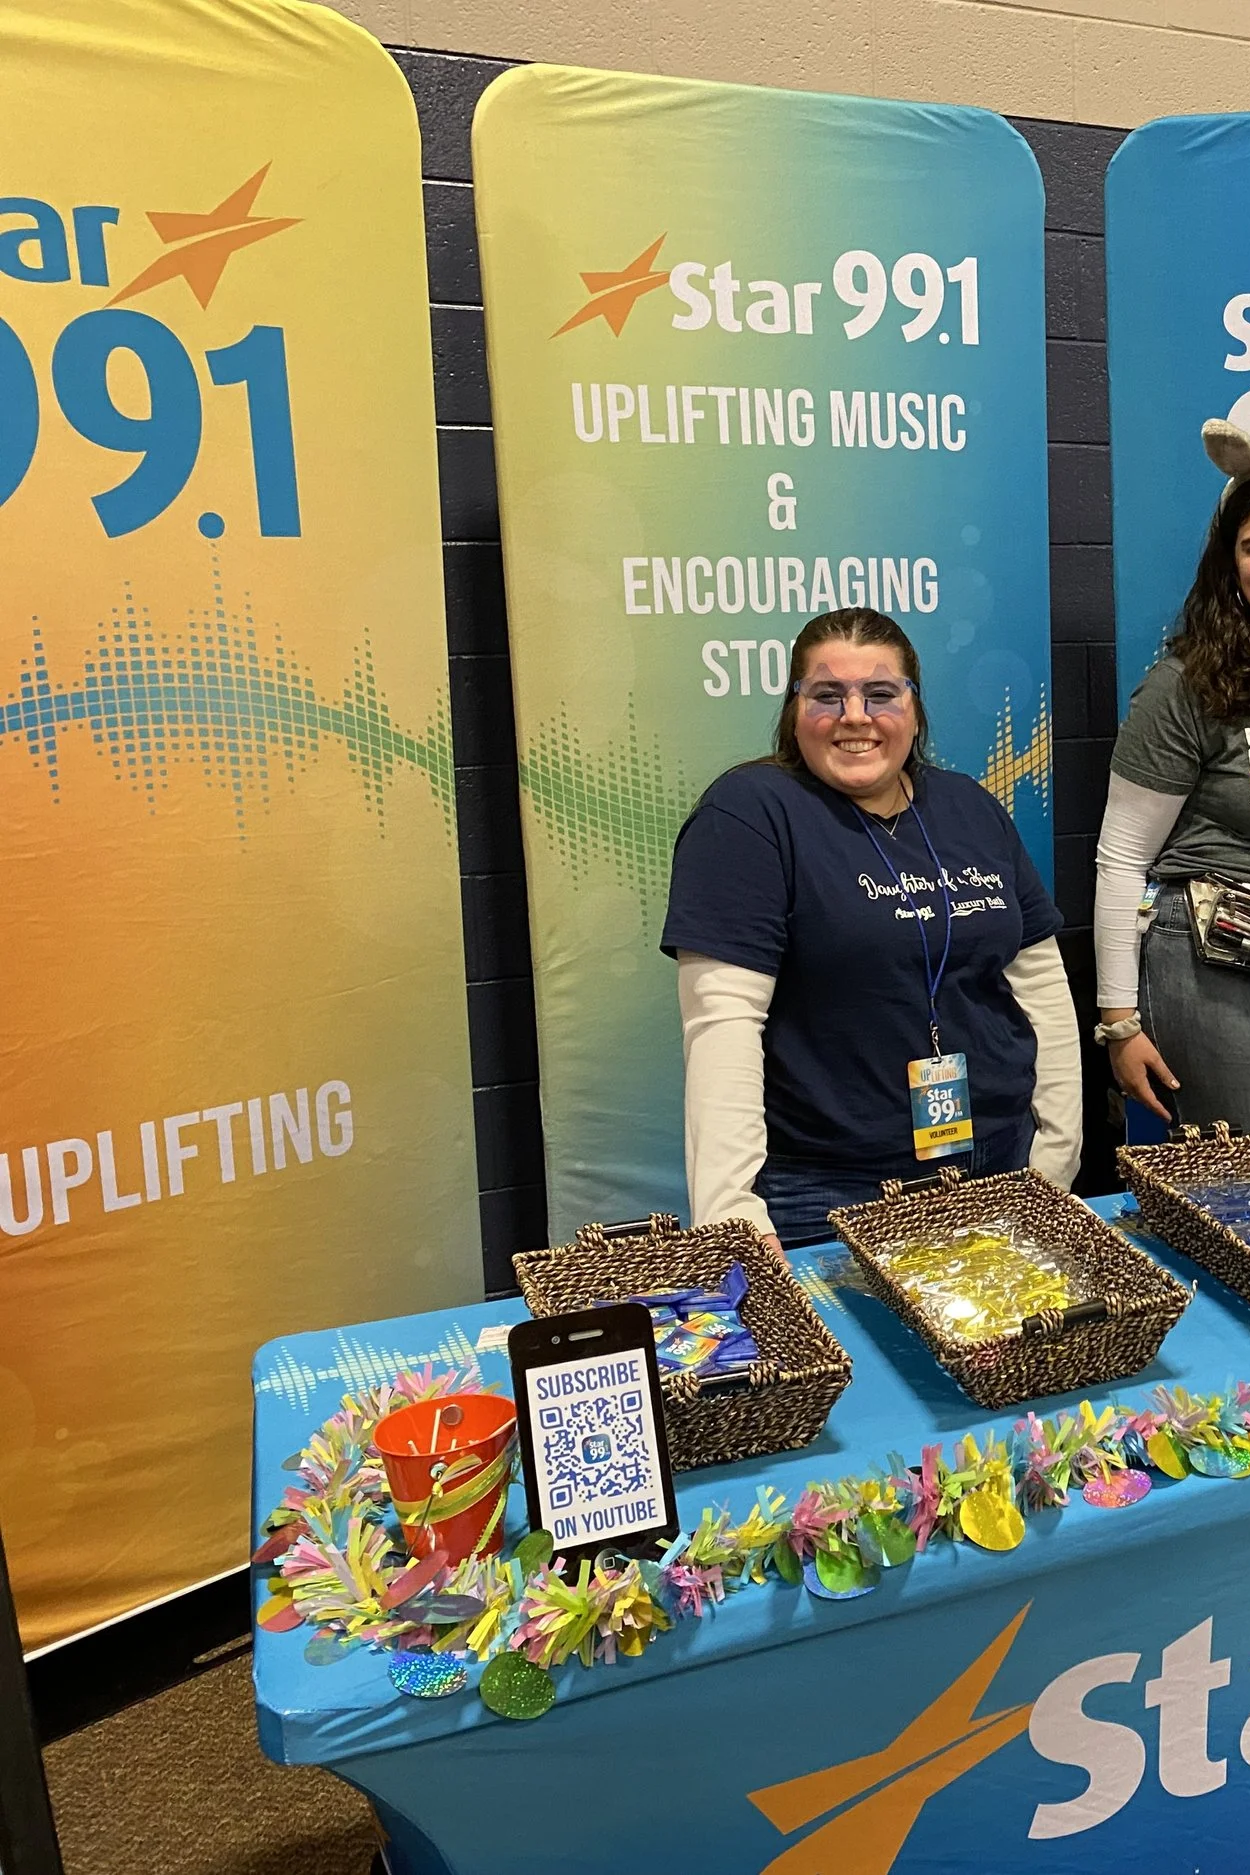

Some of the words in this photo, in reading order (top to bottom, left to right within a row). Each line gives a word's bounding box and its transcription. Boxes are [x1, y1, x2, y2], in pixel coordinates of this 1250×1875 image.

[0, 196, 120, 288] ar
[668, 260, 822, 335] Star
[832, 249, 981, 346] 99.1
[0, 308, 302, 539] 9.1
[571, 382, 815, 448] UPLIFTING
[830, 390, 967, 451] MUSIC
[766, 472, 797, 531] &
[622, 555, 939, 615] ENCOURAGING
[701, 639, 798, 697] STO
[858, 871, 936, 902] Daughter
[950, 898, 986, 911] Luxury
[985, 896, 1006, 907] Bath
[926, 1087, 954, 1103] Star
[0, 1079, 355, 1236] UPLIFTING
[929, 1126, 958, 1140] VOLUNTEER
[536, 1360, 641, 1400] SUBSCRIBE
[554, 1516, 577, 1541] ON
[581, 1498, 658, 1533] YOUTUBE
